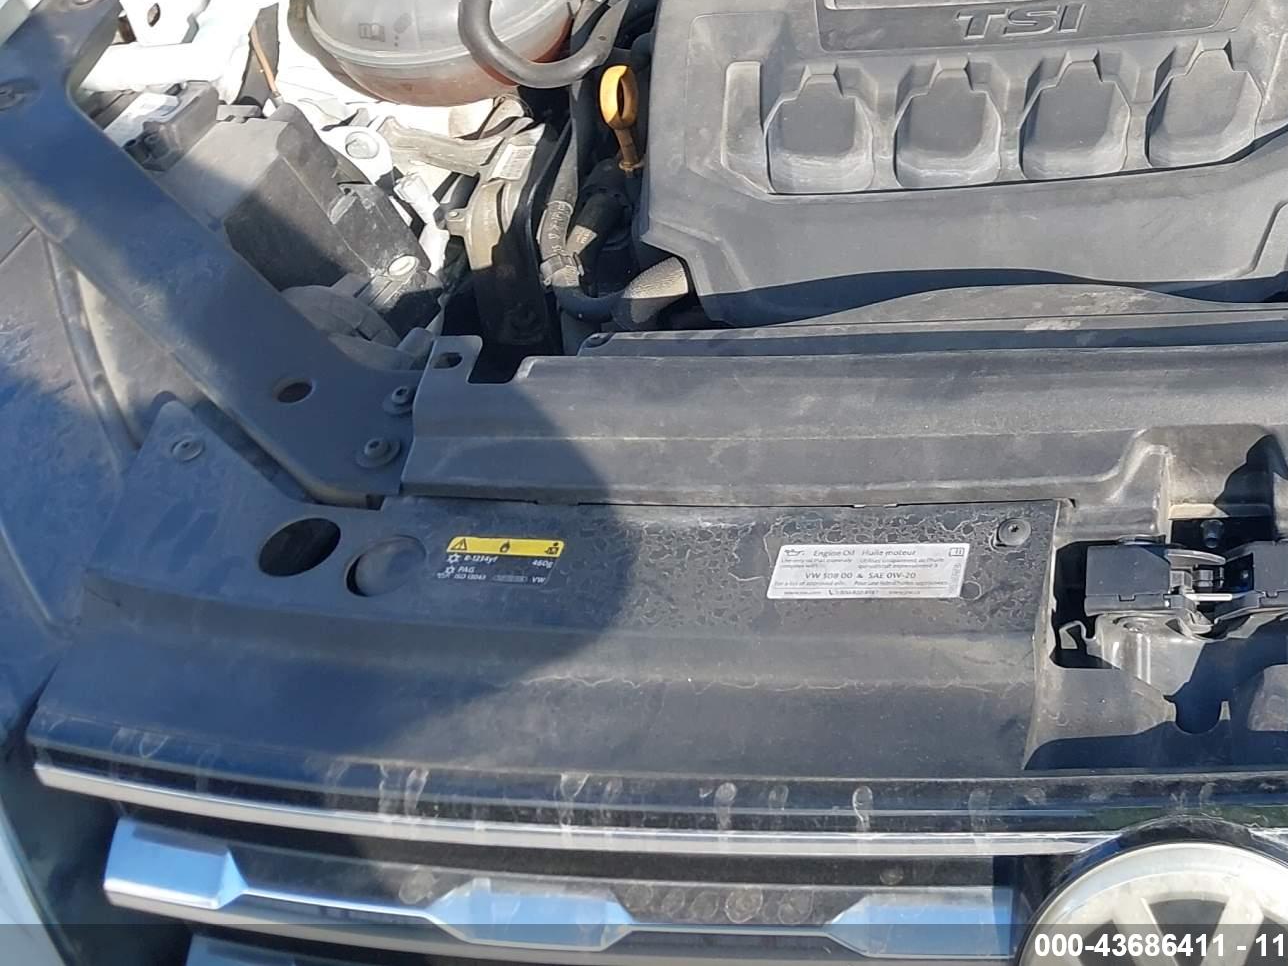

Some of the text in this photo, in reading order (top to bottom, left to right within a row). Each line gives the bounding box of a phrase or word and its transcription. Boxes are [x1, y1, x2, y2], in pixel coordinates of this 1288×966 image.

[955, 2, 1086, 40] TSI
[813, 550, 842, 558] Engine
[886, 571, 917, 579] 0W-20
